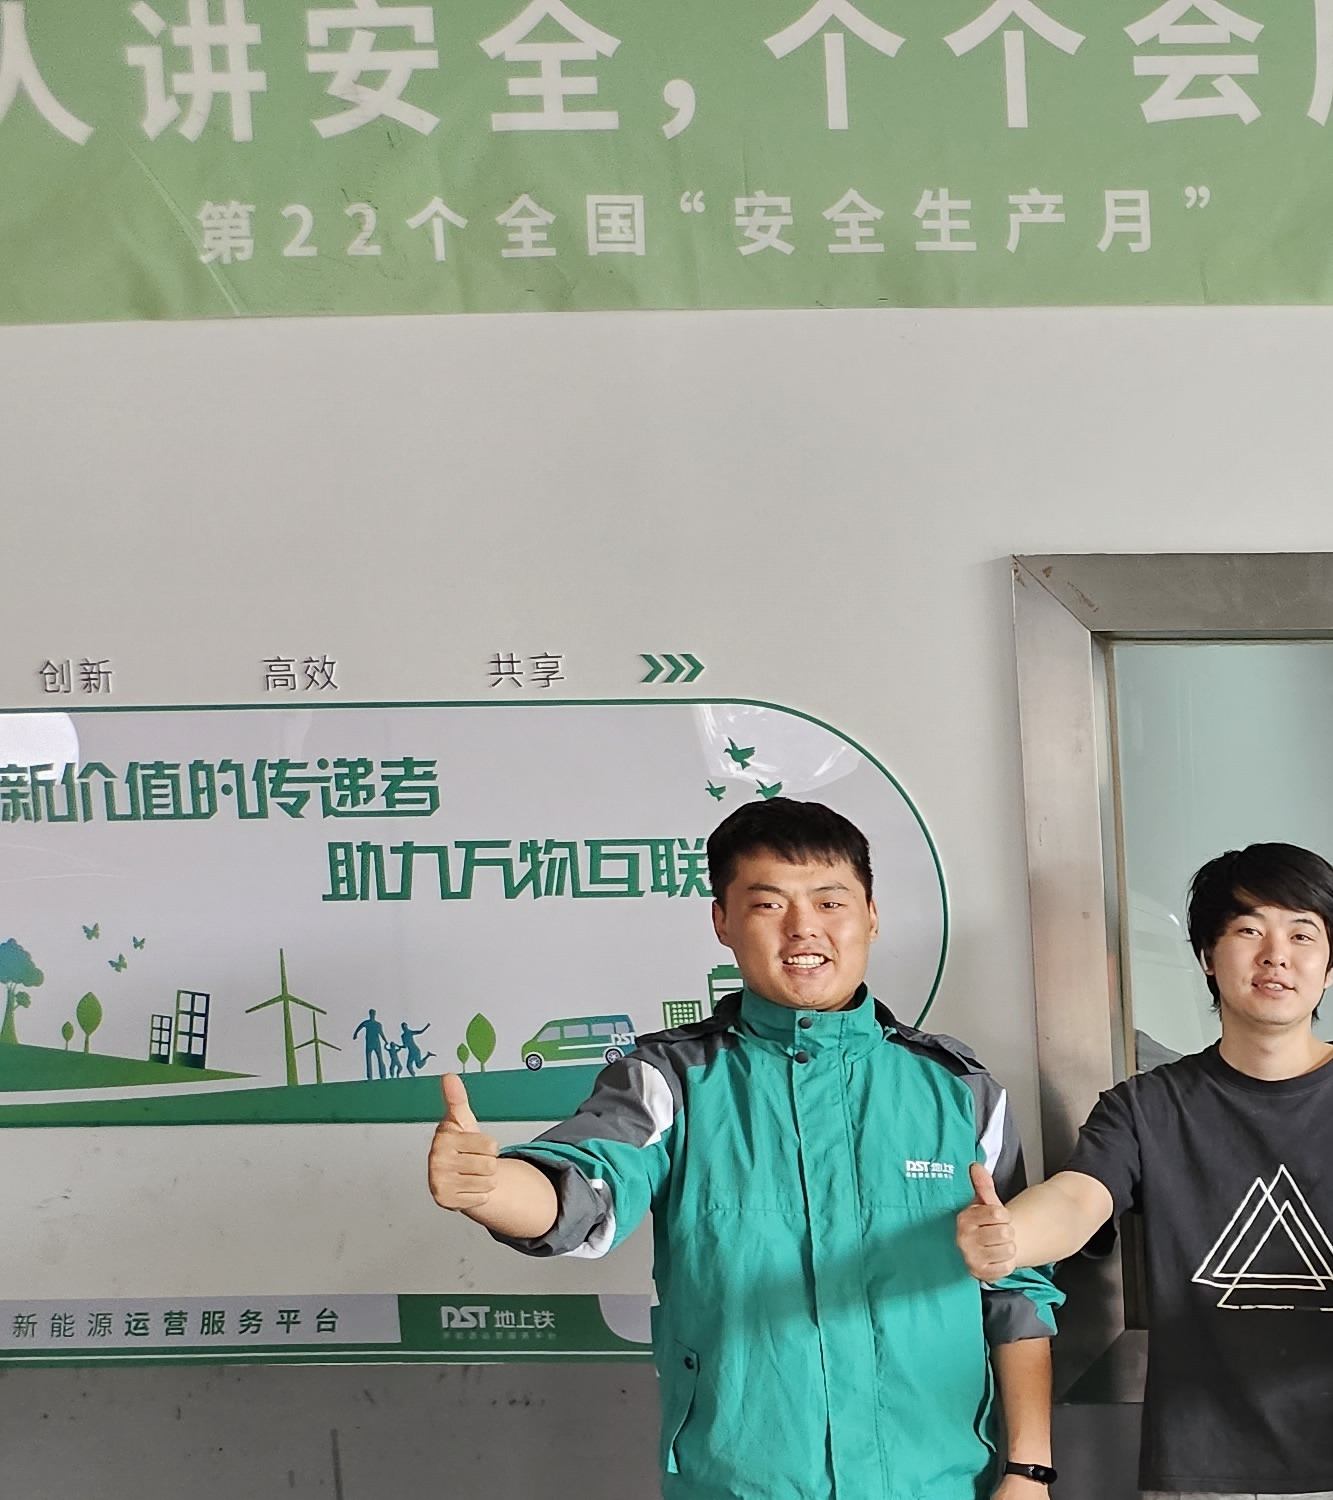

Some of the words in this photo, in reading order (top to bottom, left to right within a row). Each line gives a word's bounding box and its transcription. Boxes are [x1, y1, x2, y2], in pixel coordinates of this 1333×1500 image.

[39, 657, 113, 695] 创新
[263, 653, 339, 692] 高效
[488, 651, 566, 690] 共享
[0, 757, 441, 824] 新价值的传递者
[322, 836, 713, 903] 助力万物互联
[12, 1307, 339, 1339] 新能源运营服务平台
[440, 1305, 491, 1329] DST
[494, 1309, 556, 1329] 地上铁
